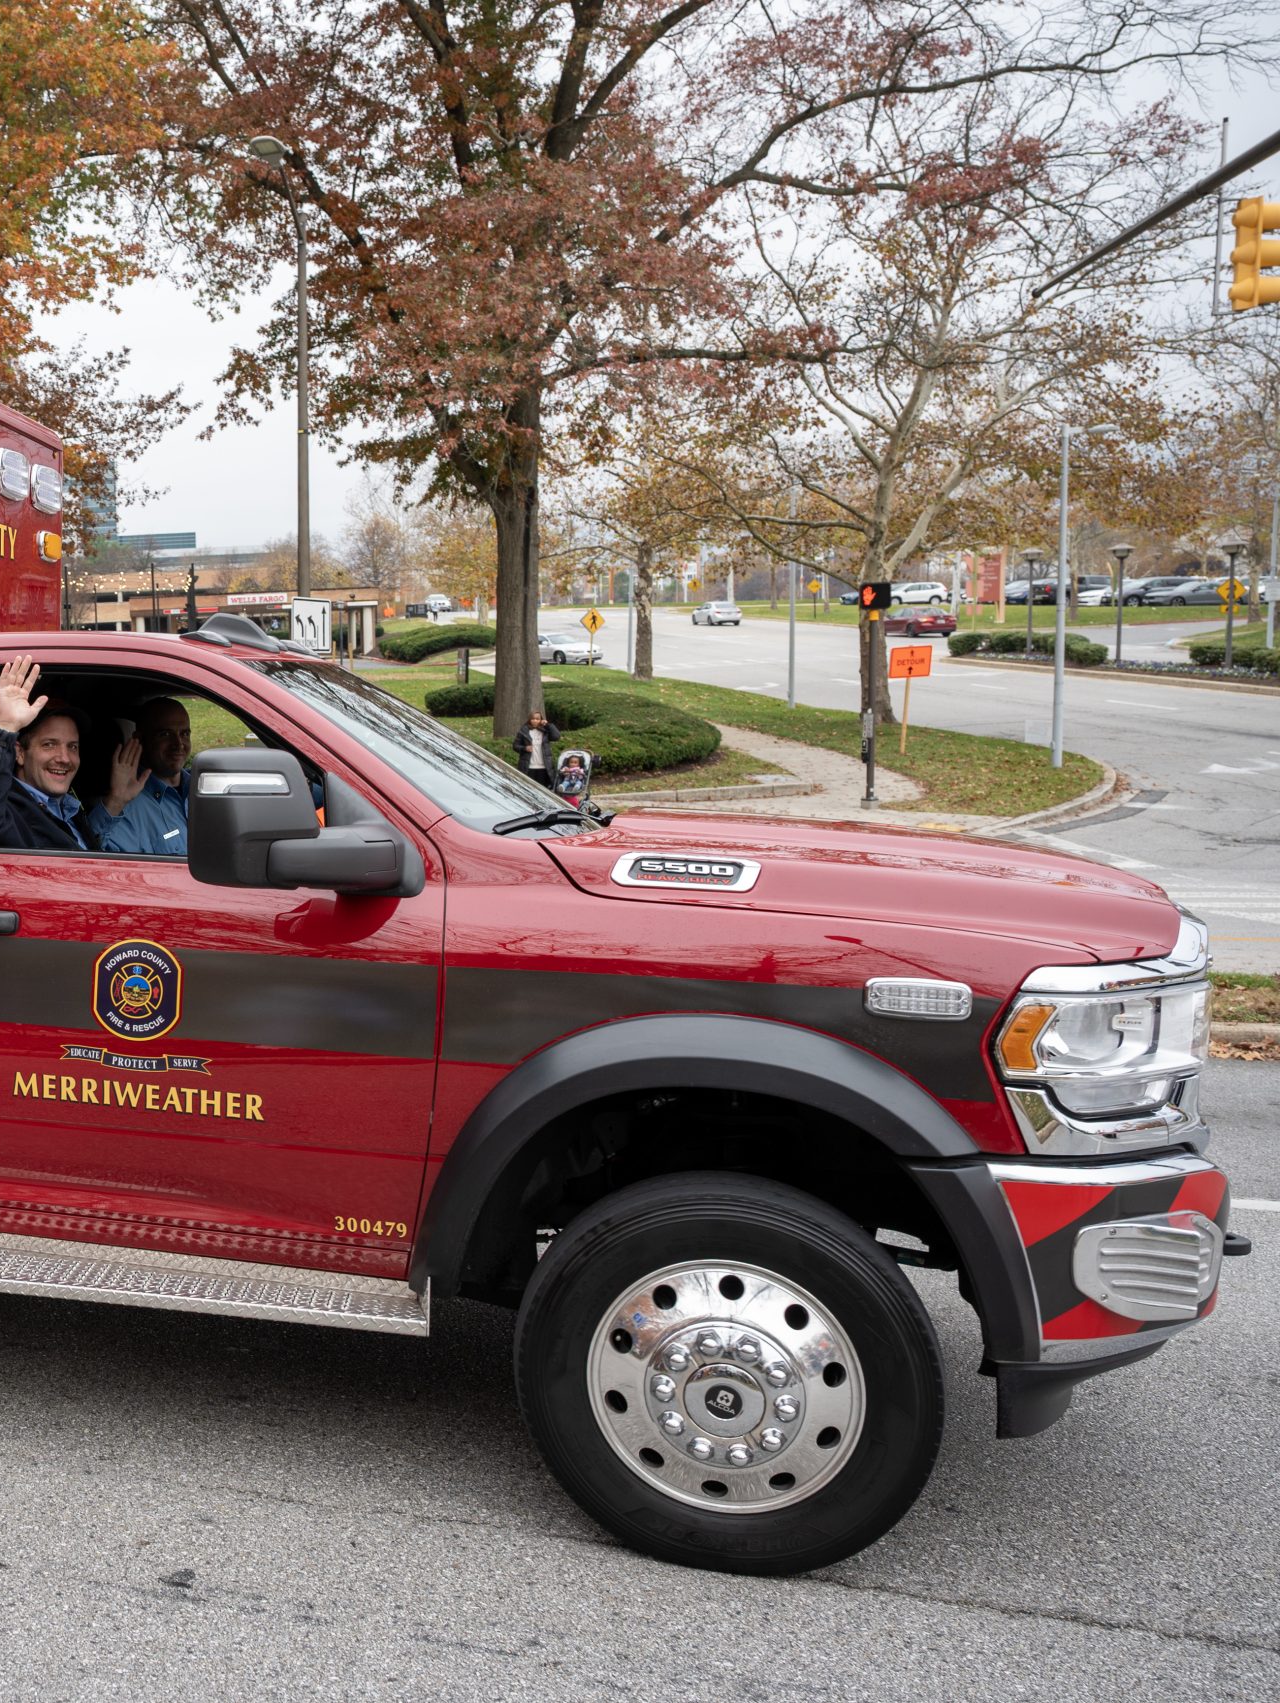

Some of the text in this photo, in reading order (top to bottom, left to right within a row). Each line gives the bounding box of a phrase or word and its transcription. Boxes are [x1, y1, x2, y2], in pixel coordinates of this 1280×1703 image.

[259, 595, 285, 603] FARGO
[636, 873, 685, 882] HEAVY
[640, 860, 734, 876] 5500
[105, 949, 172, 975] HOWARD COUNTY
[106, 1011, 165, 1032] FIRE & RESCUE
[70, 1048, 199, 1070] EDUCATE PROTECT SERVE
[12, 1071, 265, 1122] MERRIWEATHER
[334, 1215, 407, 1238] 300479
[706, 1399, 735, 1415] ALCOA
